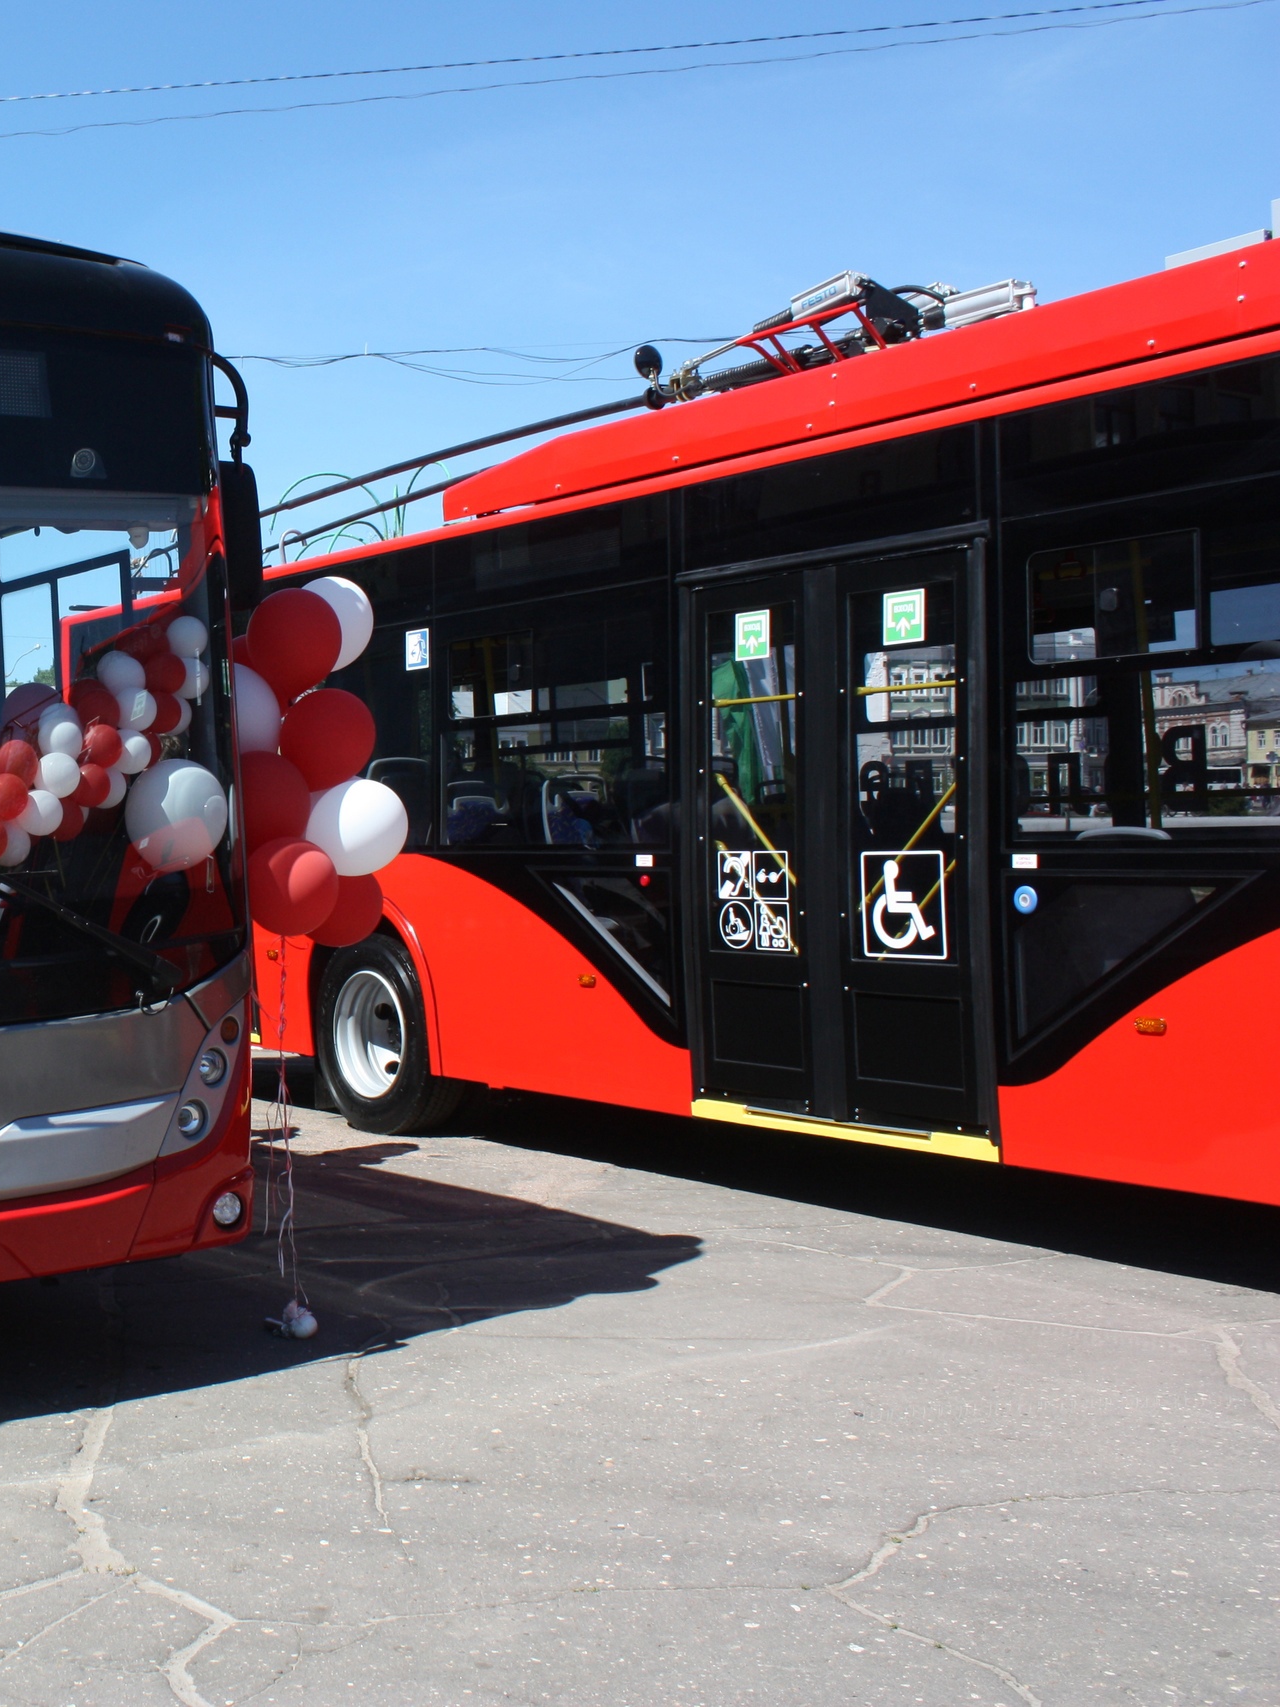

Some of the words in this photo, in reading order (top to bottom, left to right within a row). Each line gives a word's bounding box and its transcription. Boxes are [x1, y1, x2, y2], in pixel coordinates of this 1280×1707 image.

[801, 285, 838, 310] FESTO
[893, 602, 914, 614] ВХОД
[743, 622, 761, 632] ВХОД
